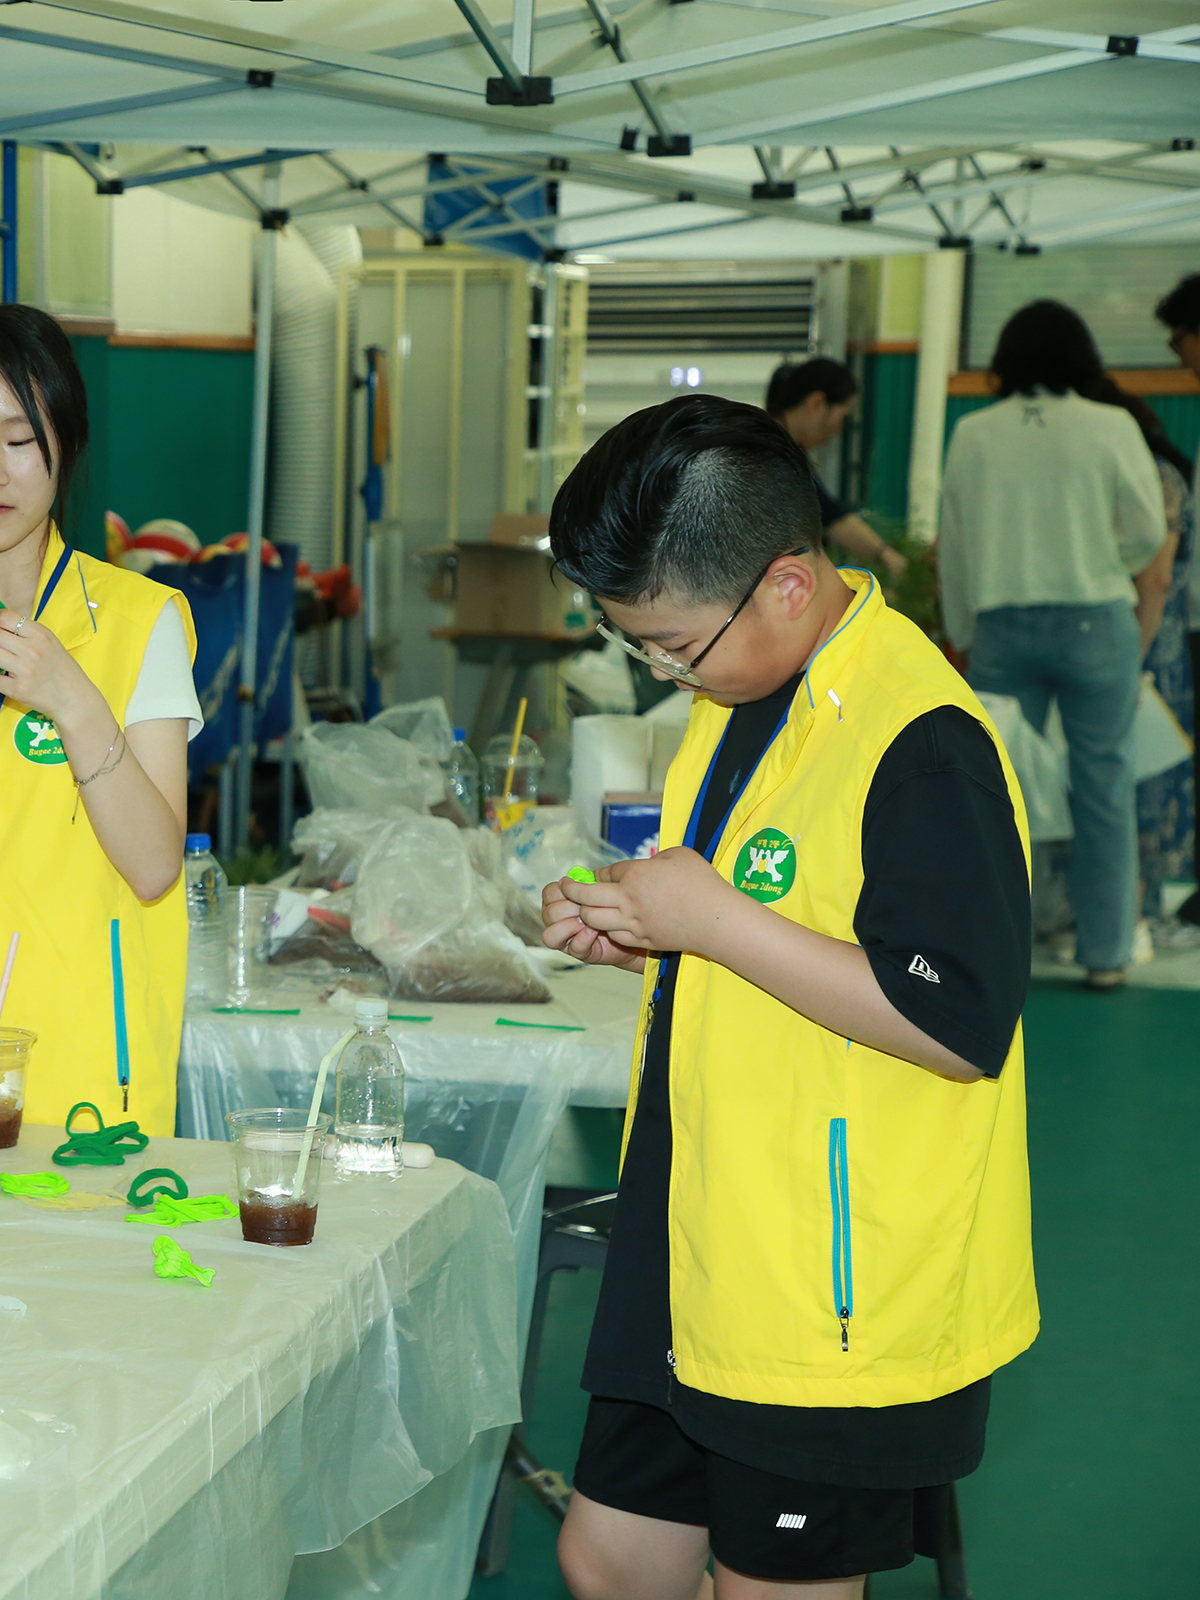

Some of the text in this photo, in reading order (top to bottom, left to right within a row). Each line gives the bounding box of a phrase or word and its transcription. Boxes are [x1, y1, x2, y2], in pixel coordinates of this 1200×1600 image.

[28, 748, 51, 757] Bugae
[740, 880, 783, 895] Bugae 2dong
